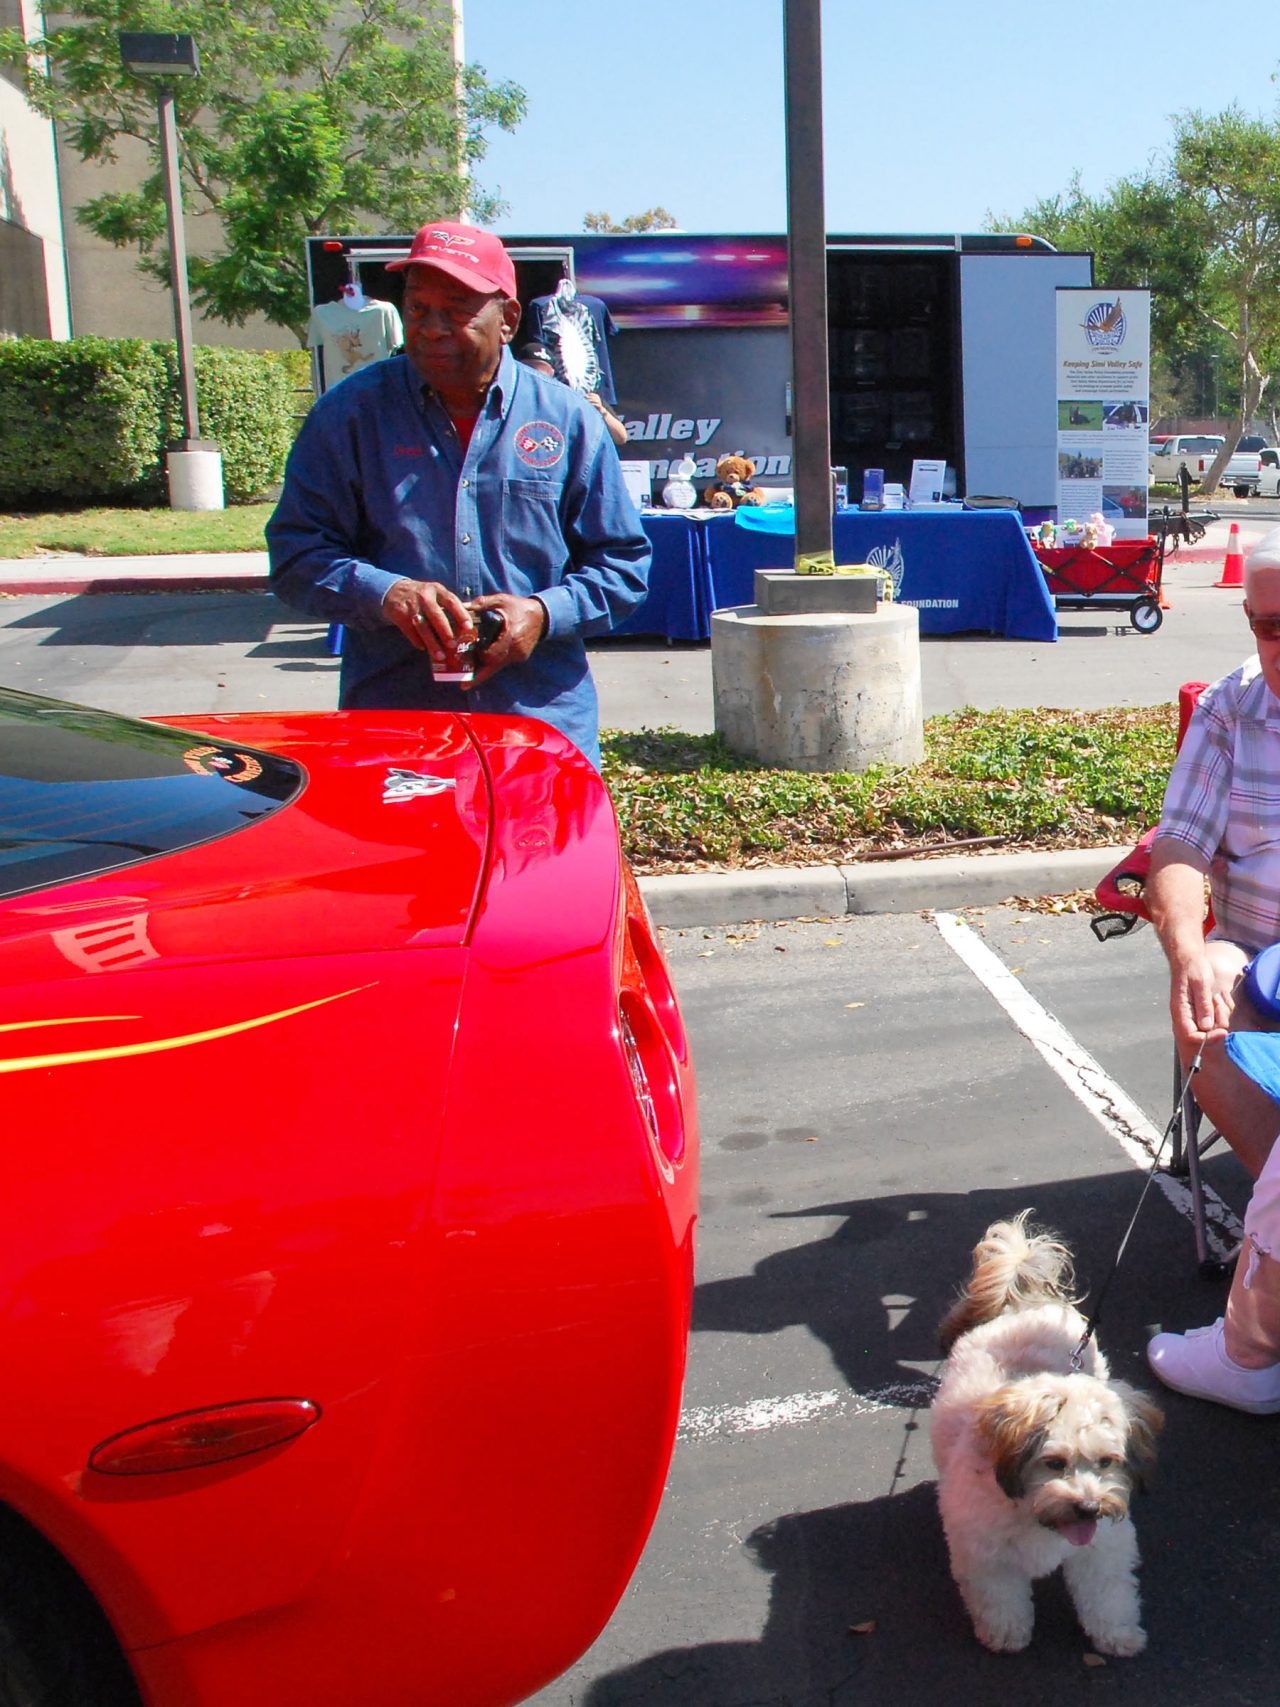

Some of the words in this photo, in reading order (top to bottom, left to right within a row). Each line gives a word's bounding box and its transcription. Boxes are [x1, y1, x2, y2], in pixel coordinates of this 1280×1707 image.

[1062, 360, 1090, 369] Keeping
[1091, 360, 1105, 368] Simi
[1107, 360, 1127, 369] Valley
[1128, 360, 1143, 369] Safe
[620, 413, 721, 446] alley
